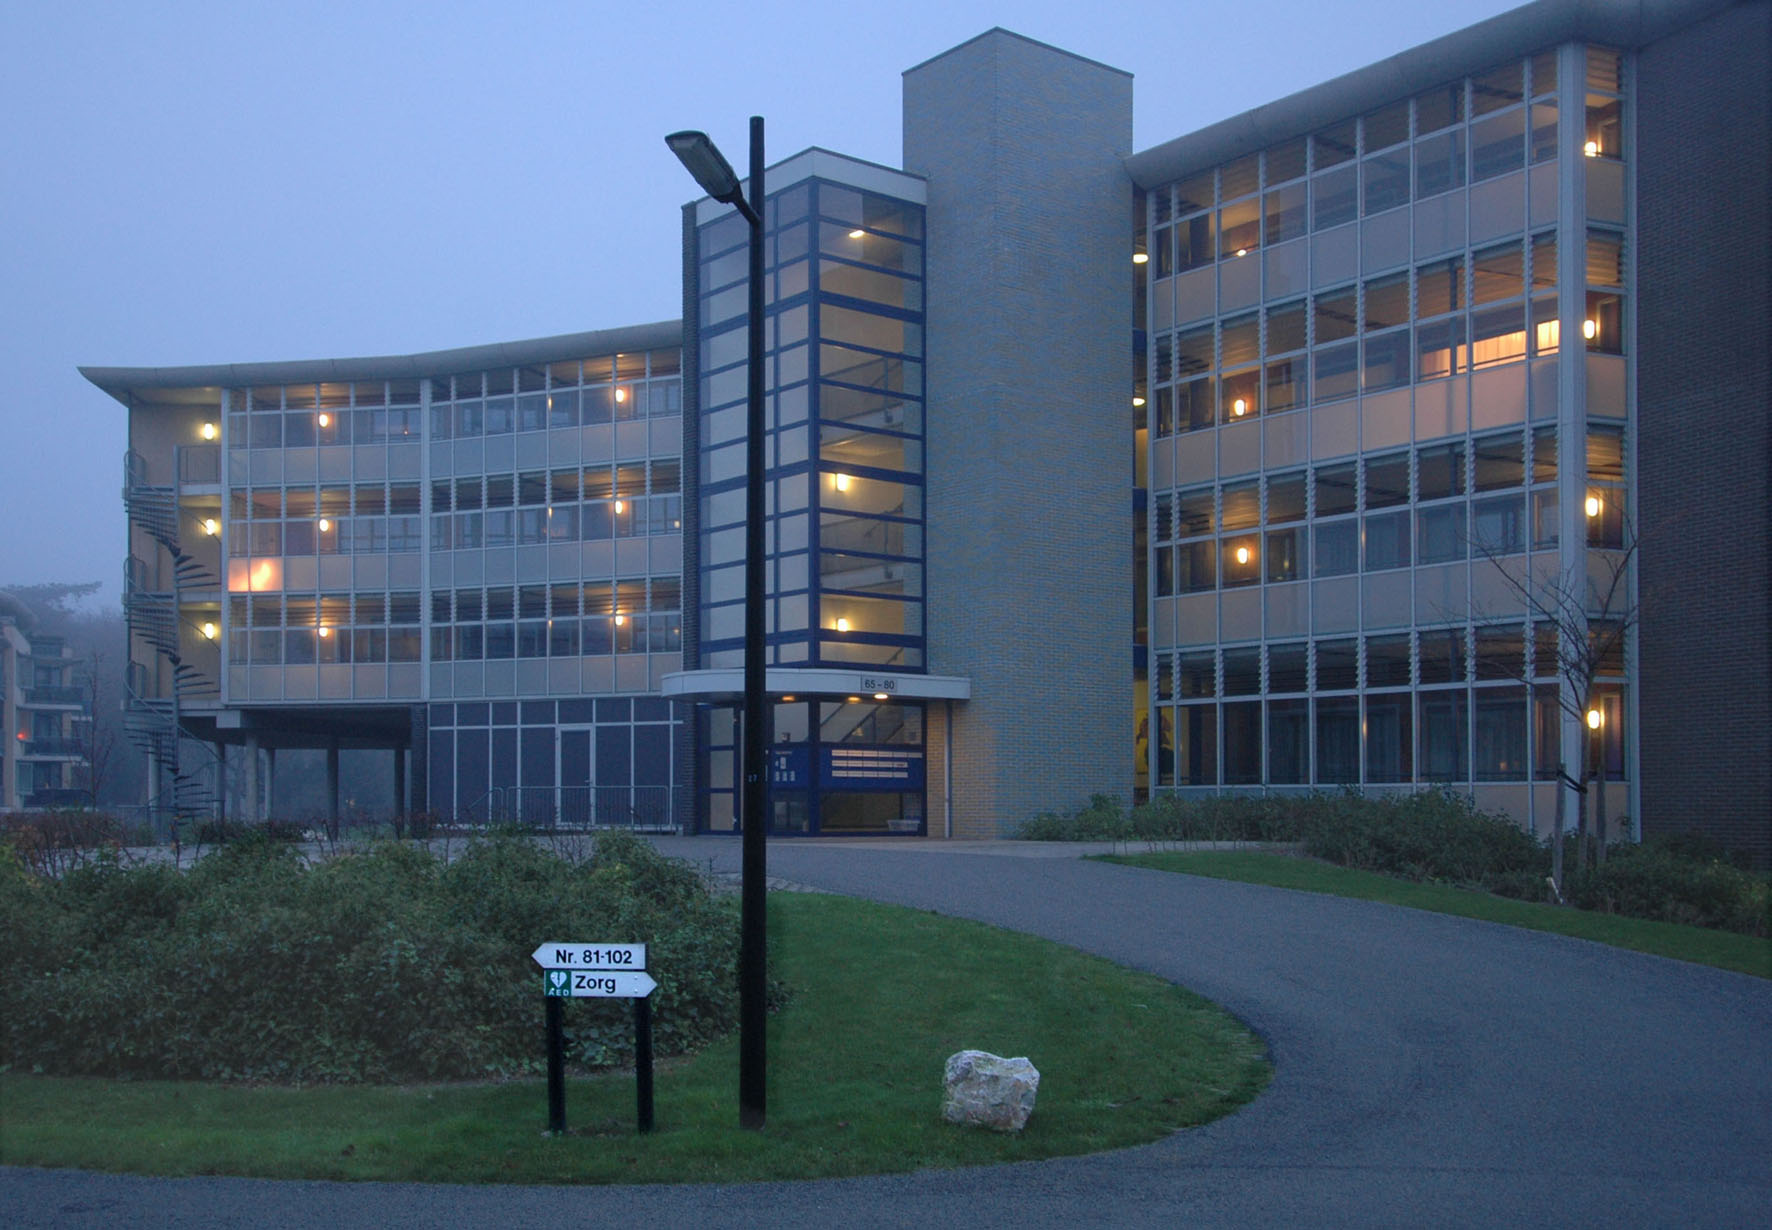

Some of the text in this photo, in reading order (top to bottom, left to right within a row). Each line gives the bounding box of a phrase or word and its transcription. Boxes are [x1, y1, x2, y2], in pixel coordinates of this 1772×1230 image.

[864, 679, 876, 689] 65
[883, 680, 895, 690] 80
[555, 949, 632, 964] Nr. 81-102
[574, 975, 616, 994] Zorg
[548, 987, 570, 996] AED
